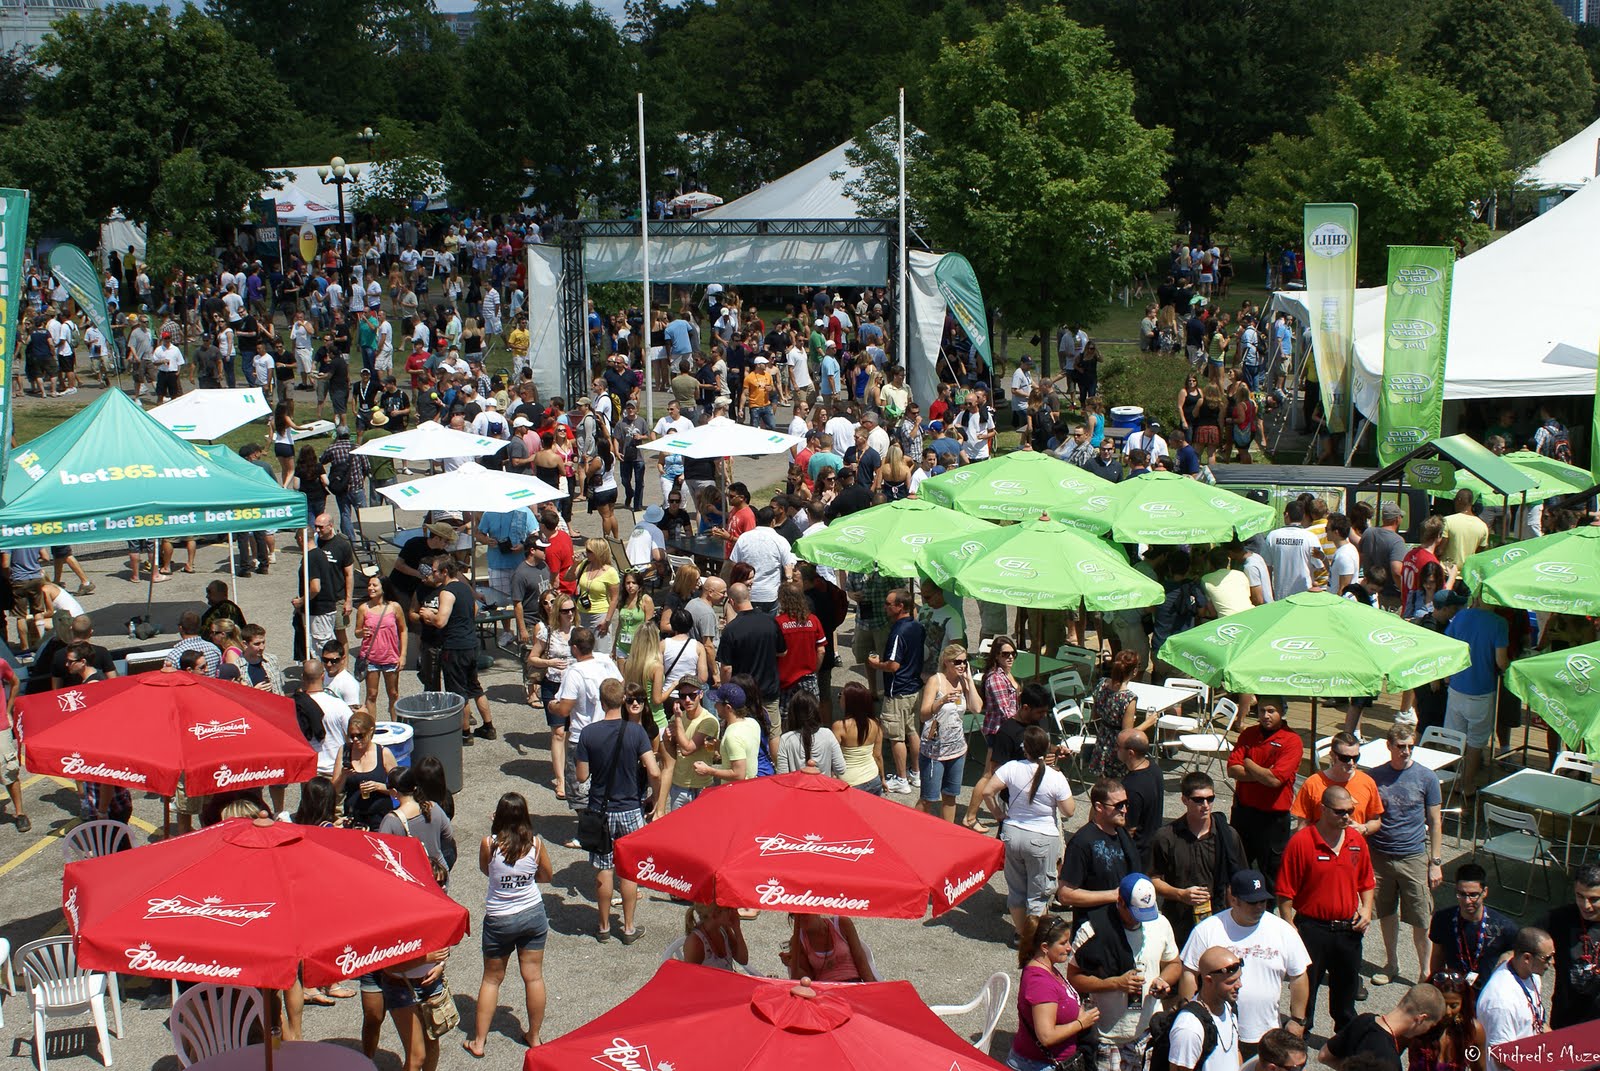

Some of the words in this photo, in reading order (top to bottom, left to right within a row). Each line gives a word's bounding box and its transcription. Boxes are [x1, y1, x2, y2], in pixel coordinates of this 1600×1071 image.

[60, 465, 210, 485] bet365.net
[105, 512, 196, 531] bet365.net
[205, 505, 293, 524] bet365.net
[1, 519, 97, 537] bet365.net
[1004, 560, 1034, 570] BL
[1544, 565, 1576, 575] BL
[1282, 640, 1320, 650] BL
[1569, 658, 1596, 680] BL
[1330, 676, 1352, 687] Lime
[1529, 684, 1549, 701] BUD
[188, 722, 251, 736] Budweiser
[61, 756, 146, 784] Budweiser
[213, 766, 284, 788] Budweiser
[755, 836, 874, 855] Budweiser
[637, 860, 693, 893] Budweiser
[756, 883, 870, 909] Budweiser
[943, 870, 985, 906] Budweiser
[147, 898, 271, 920] Budweiser
[125, 947, 242, 978] Budweiser
[335, 939, 422, 976] Budweiser
